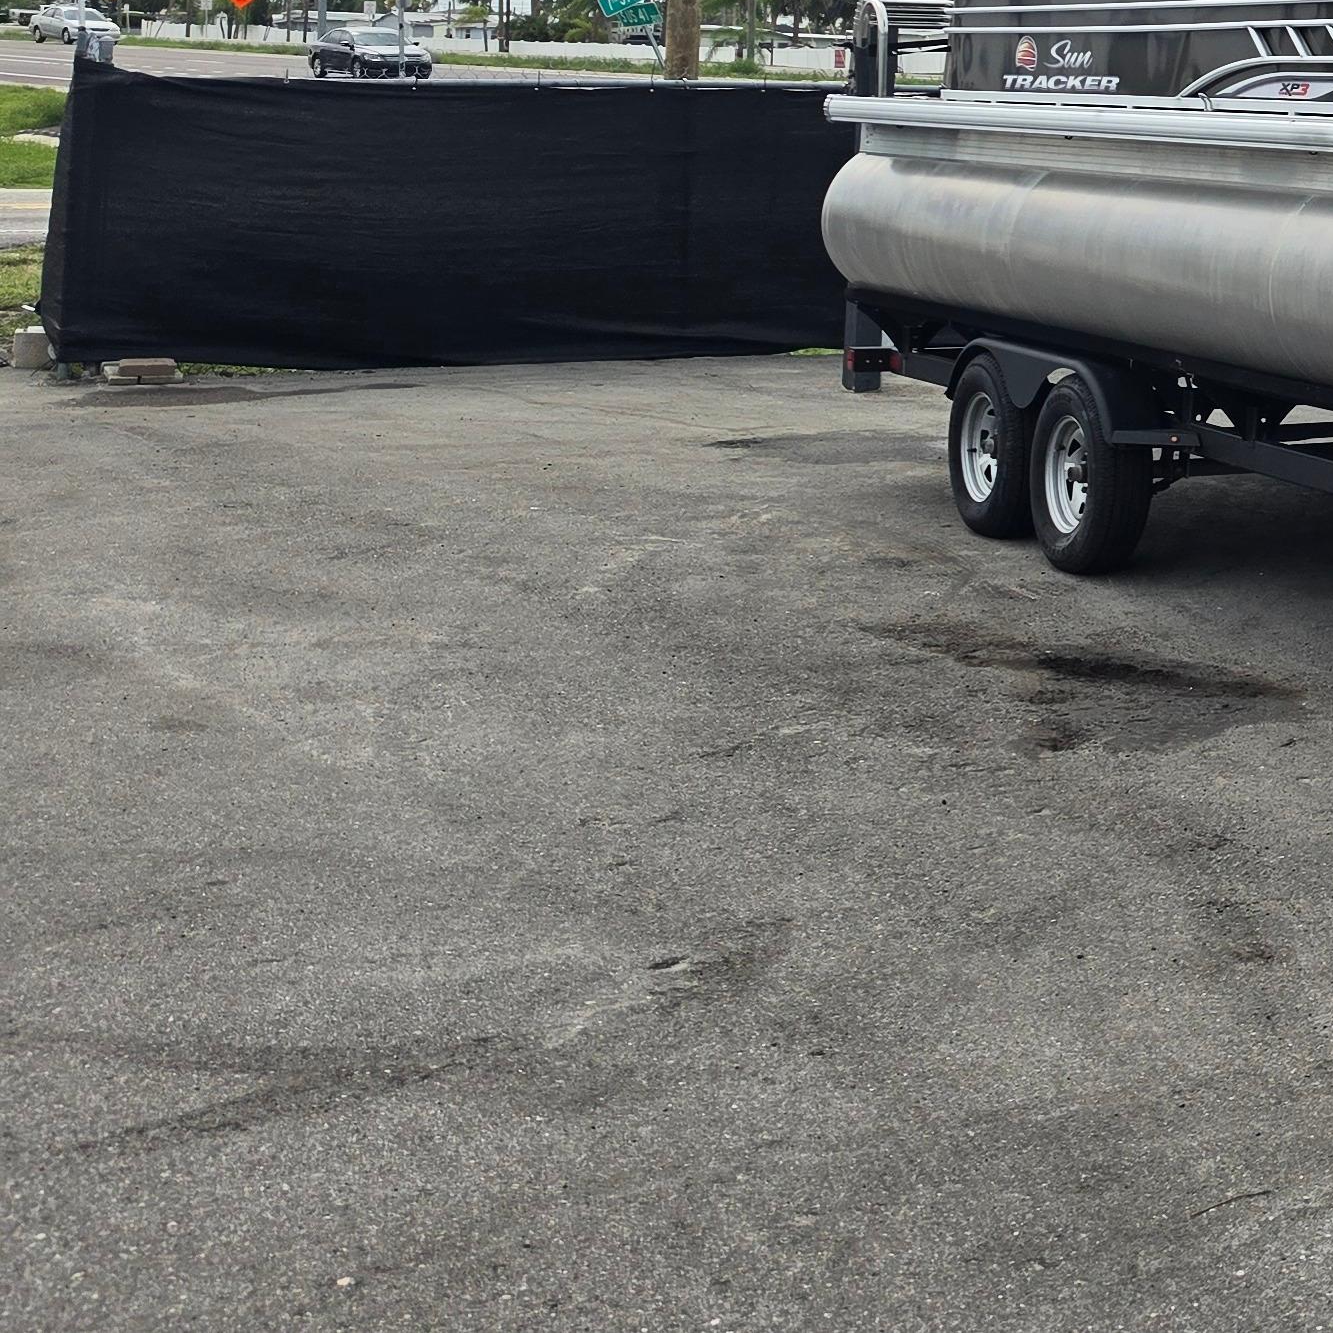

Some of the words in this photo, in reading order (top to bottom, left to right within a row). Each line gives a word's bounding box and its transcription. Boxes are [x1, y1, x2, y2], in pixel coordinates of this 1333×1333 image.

[1043, 39, 1093, 68] Sun
[1003, 74, 1120, 92] TRACKER
[1279, 82, 1310, 96] XP3
